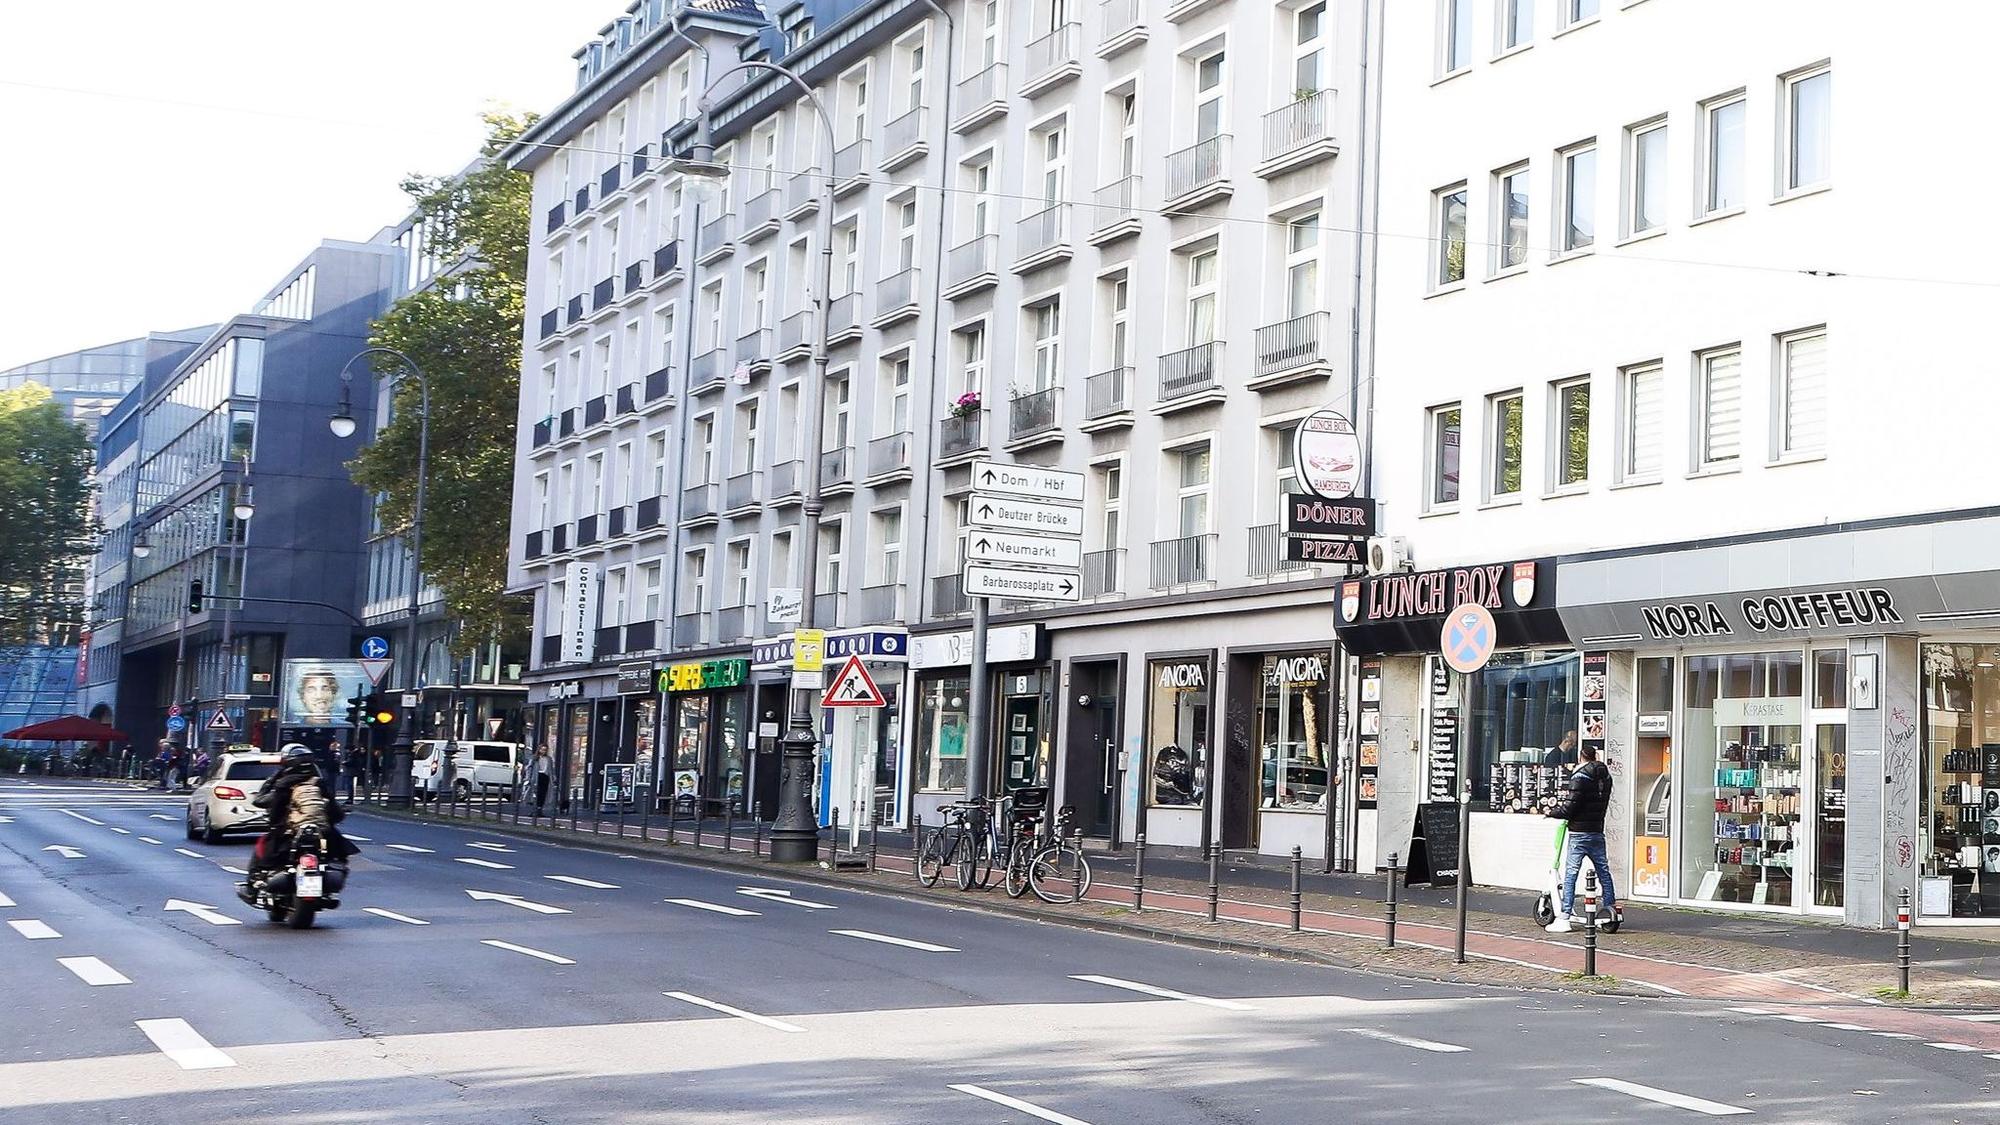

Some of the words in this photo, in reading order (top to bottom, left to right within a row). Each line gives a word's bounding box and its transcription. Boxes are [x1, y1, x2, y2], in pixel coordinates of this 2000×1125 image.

[1310, 419, 1333, 431] LUNCH
[1001, 473, 1029, 487] Dom
[1044, 478, 1065, 491] Hbf
[1314, 479, 1351, 492] HAMBURGER
[998, 507, 1033, 521] Deutzer
[1037, 509, 1068, 525] Brücke
[1296, 501, 1366, 526] DÖNER
[996, 542, 1056, 557] Neumarkt
[1301, 540, 1359, 561] PIZZA
[983, 575, 1055, 592] Barbarossaplatz
[1368, 571, 1446, 620] LUNCH
[1453, 565, 1504, 609] BOX
[575, 567, 589, 657] Contactlinsen
[1641, 601, 1735, 640] NORA
[1741, 587, 1905, 633] COIFFEUR
[1158, 664, 1205, 688] ANCORA
[1273, 656, 1326, 682] ANCORA
[1637, 868, 1669, 888] Cash
